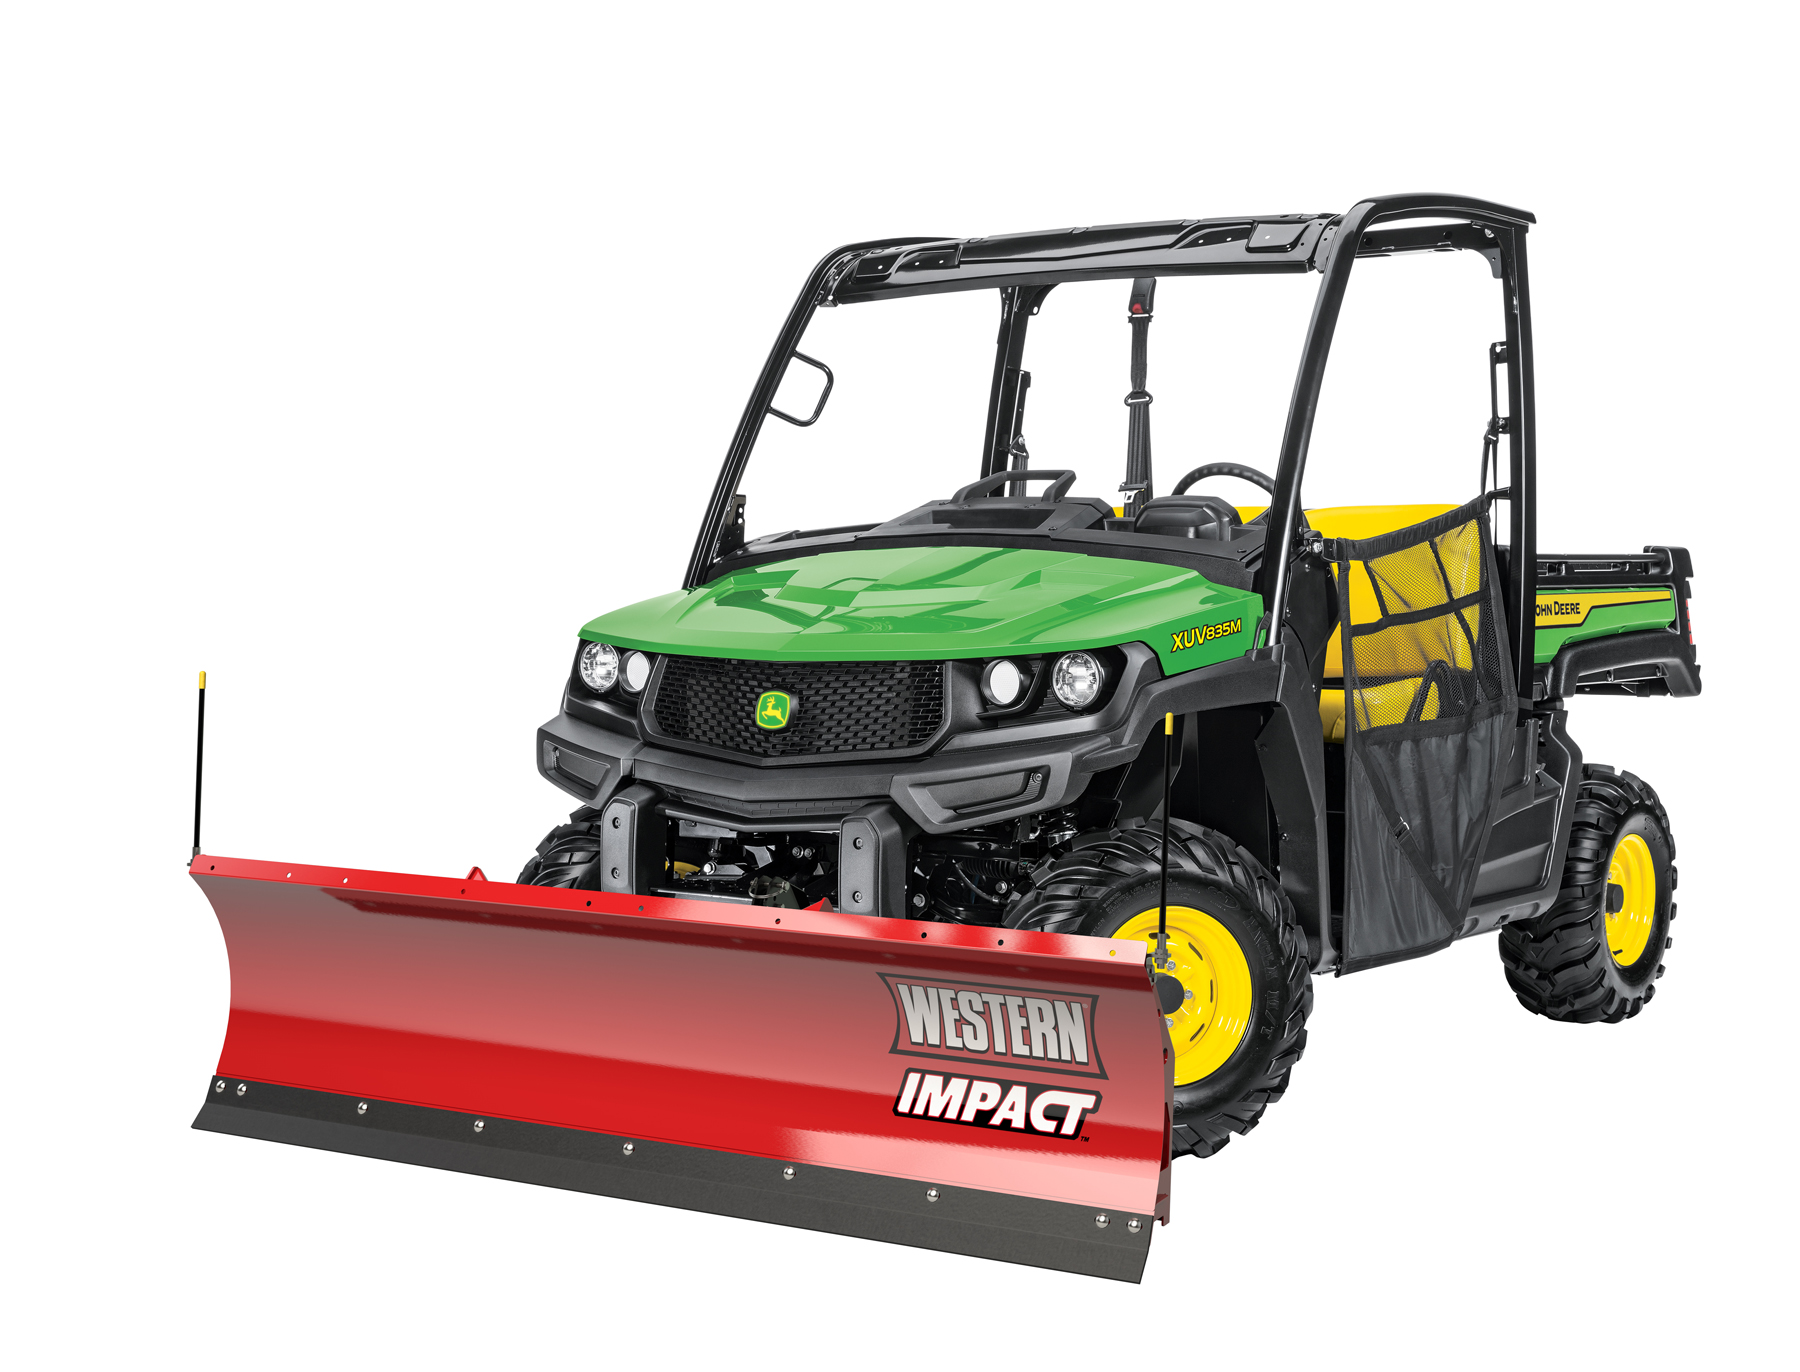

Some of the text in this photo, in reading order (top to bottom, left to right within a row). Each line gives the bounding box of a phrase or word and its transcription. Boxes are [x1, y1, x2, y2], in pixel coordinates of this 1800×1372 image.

[1535, 601, 1581, 617] OHN DEERE
[1170, 617, 1242, 653] XUV835M
[895, 983, 1090, 1066] WESTERN
[896, 1071, 1097, 1137] IMPACT
